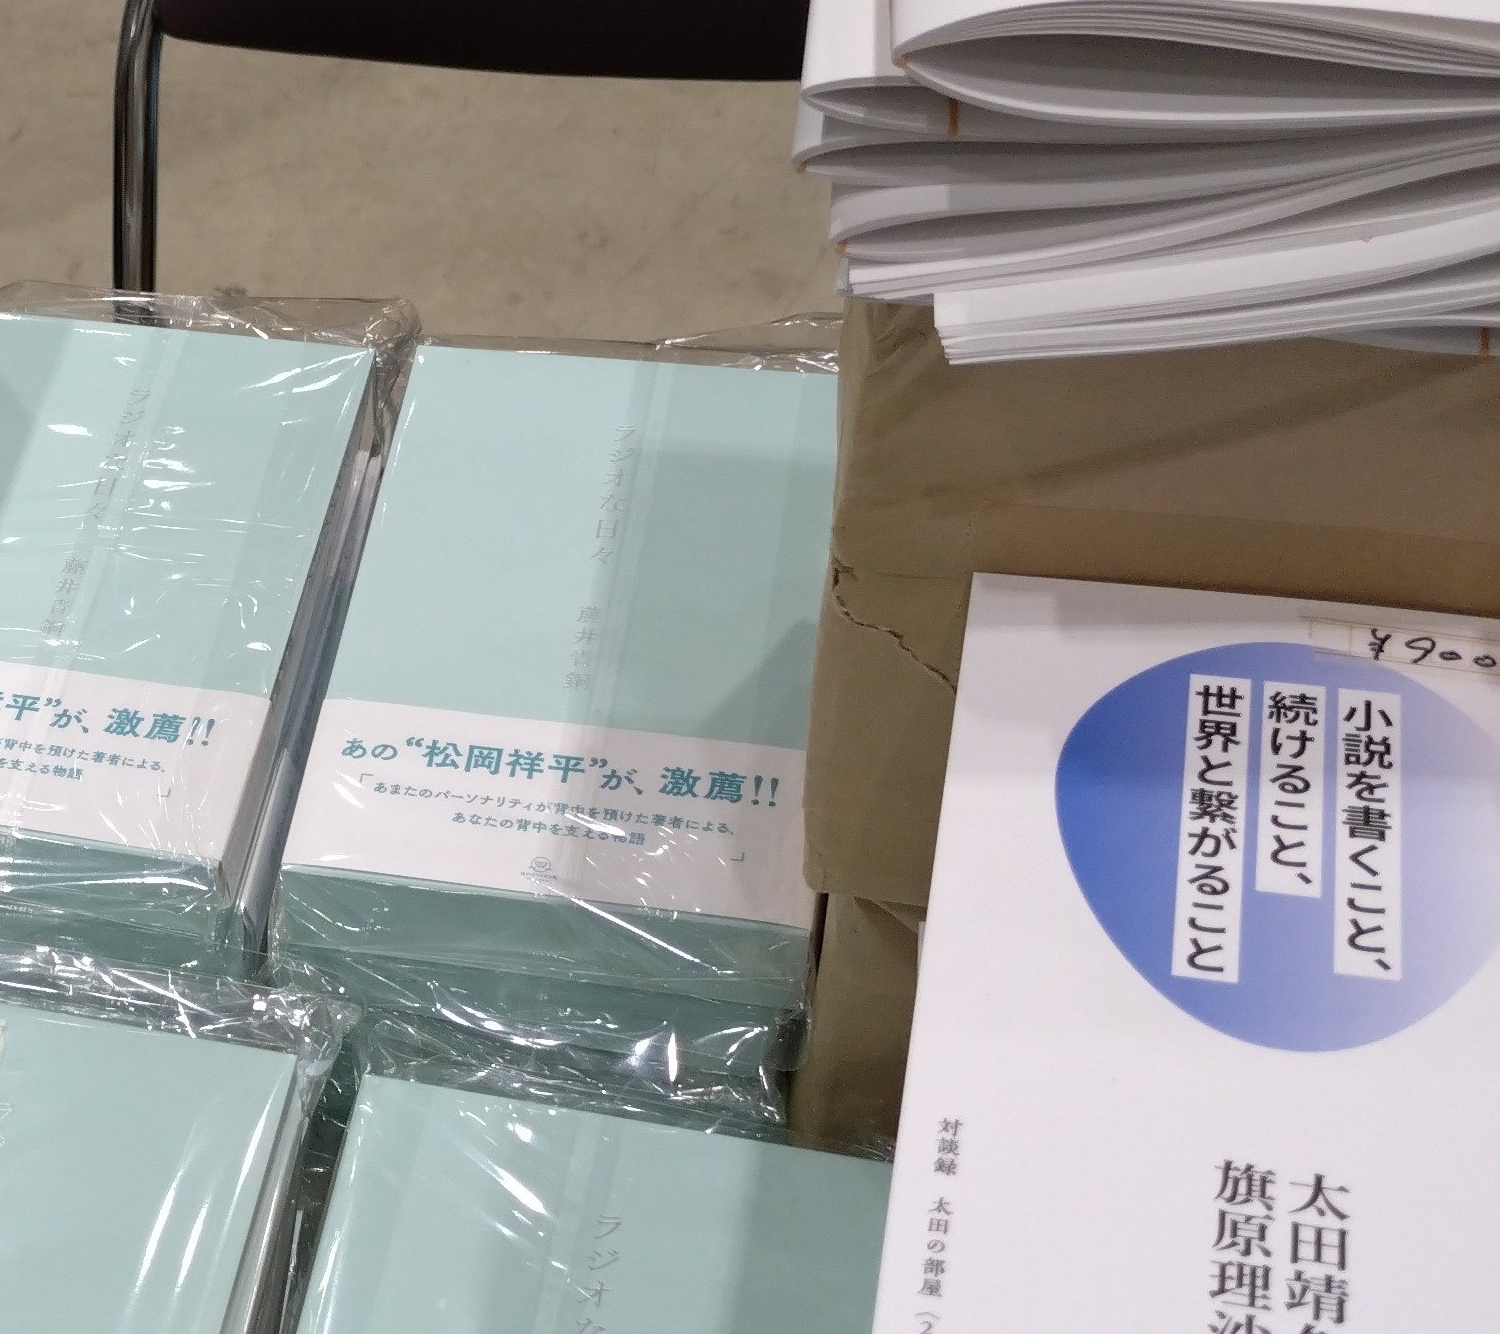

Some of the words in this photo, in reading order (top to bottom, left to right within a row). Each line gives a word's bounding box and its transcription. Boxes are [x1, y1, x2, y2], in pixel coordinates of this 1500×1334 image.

[1186, 685, 1244, 974] 世界と繋がること
[1266, 692, 1319, 891] 続けること、
[1340, 698, 1395, 974] 小説を書くこと、
[932, 1116, 965, 1178] 対談録
